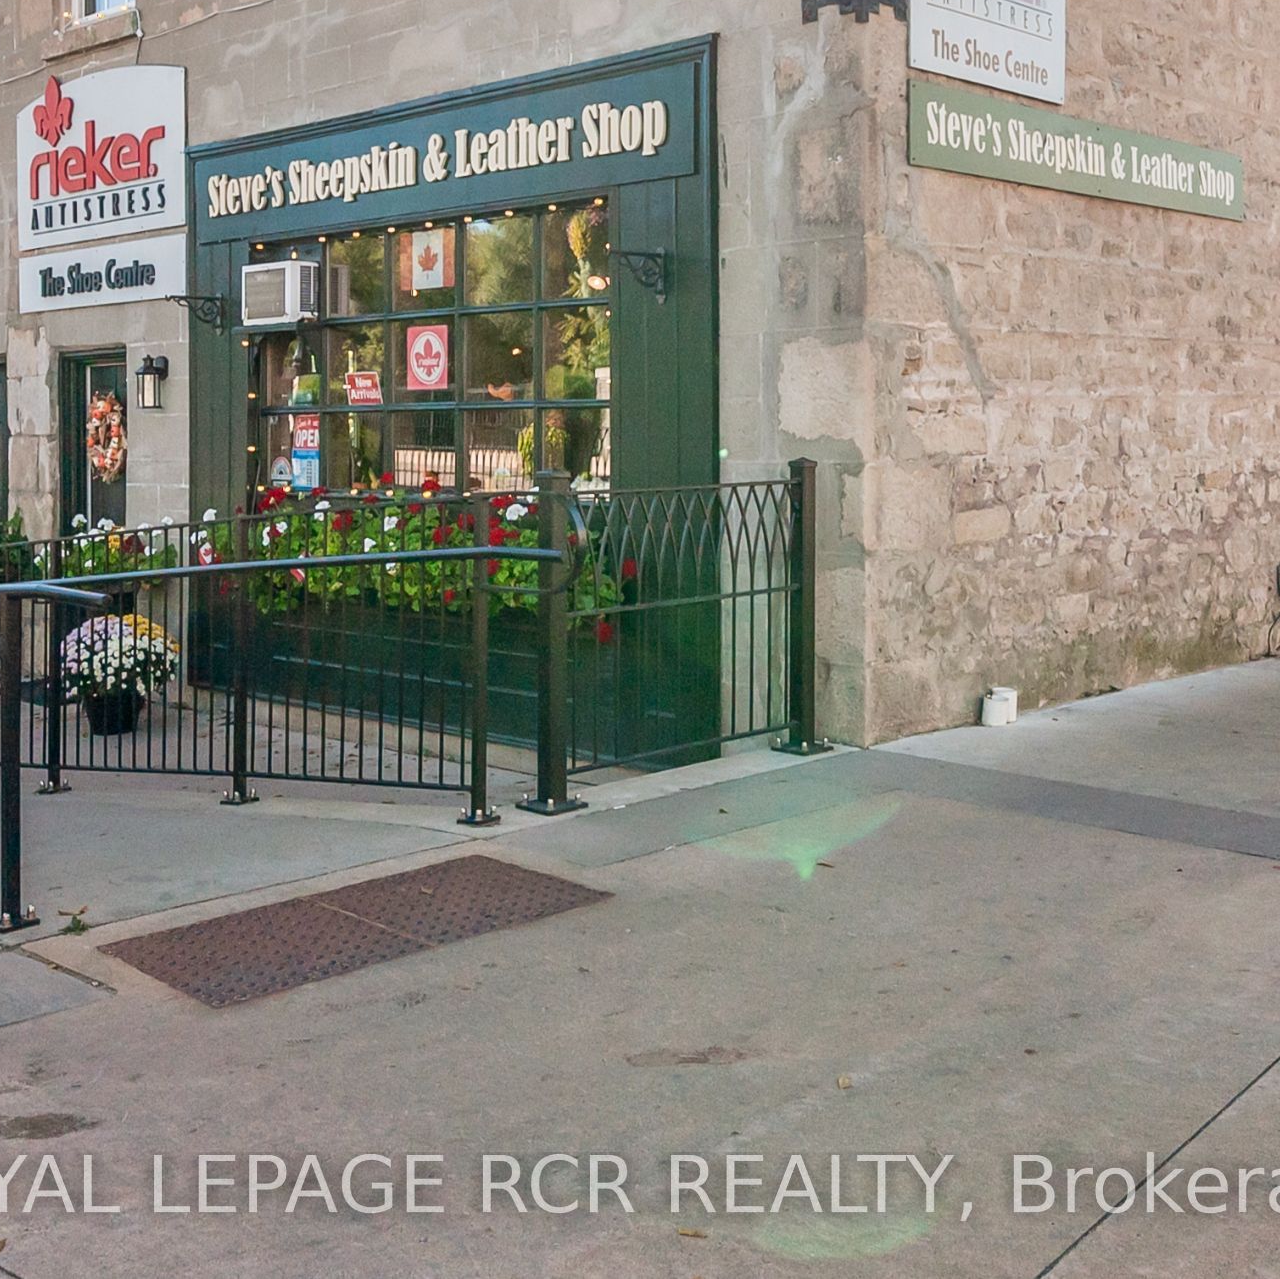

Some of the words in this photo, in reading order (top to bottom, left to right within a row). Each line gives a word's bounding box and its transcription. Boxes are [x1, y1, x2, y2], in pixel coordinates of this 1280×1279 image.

[932, 28, 960, 63] The
[964, 38, 1000, 73] Shoe
[1005, 50, 1049, 86] Centre
[30, 120, 166, 200] rieker
[207, 165, 286, 218] Steve's
[288, 141, 417, 203] Sheepskin
[423, 133, 448, 183] &
[454, 116, 574, 178] Leather
[581, 100, 668, 157] Shop
[926, 101, 1002, 157] Steve's
[1008, 118, 1106, 177] Sheepskin
[1111, 141, 1126, 180] &
[1130, 145, 1195, 194] Leather
[1199, 160, 1235, 206] Shop
[31, 184, 166, 231] ANTISTRESS
[39, 267, 65, 298] The
[67, 262, 103, 295] Shoe
[105, 258, 156, 290] Centre
